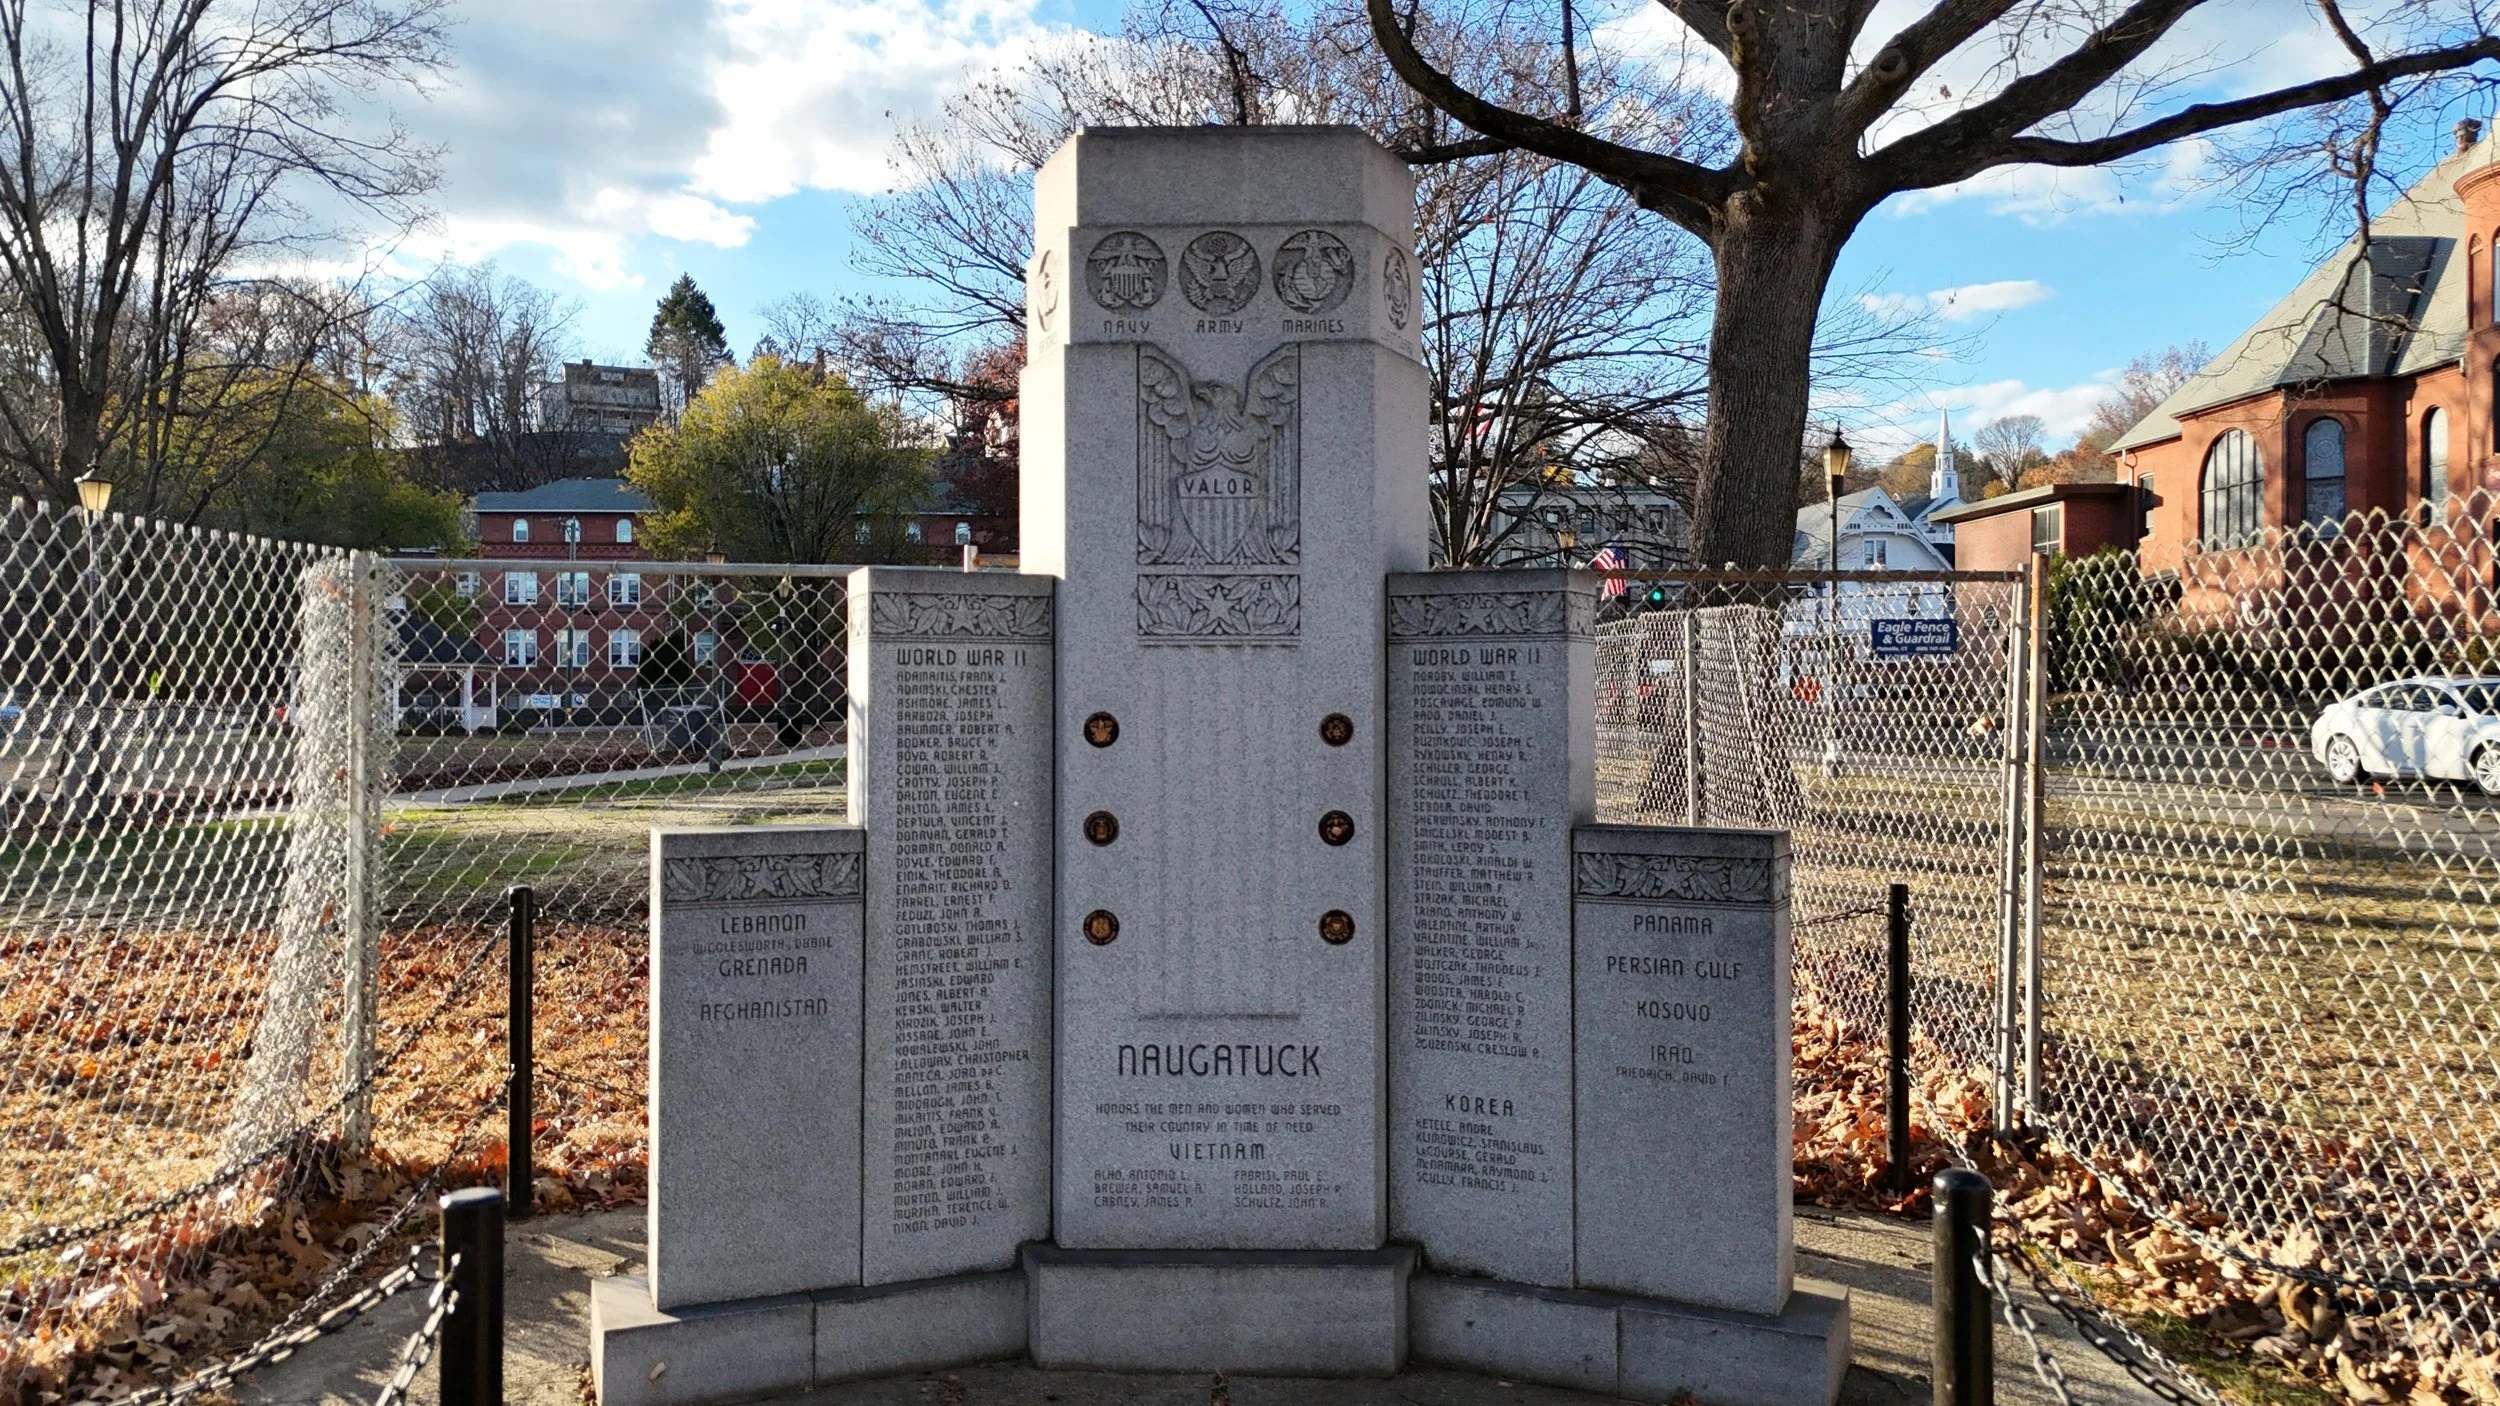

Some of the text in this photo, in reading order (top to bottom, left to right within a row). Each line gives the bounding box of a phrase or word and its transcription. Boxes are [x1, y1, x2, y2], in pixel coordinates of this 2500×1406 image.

[1103, 320, 1149, 334] NAVY
[1196, 320, 1242, 333] ARMY
[1282, 319, 1343, 333] MARINES
[1185, 479, 1252, 494] VALOR
[1878, 622, 1949, 634] Eagle Fence
[1883, 633, 1950, 643] & Guardrail
[898, 649, 1025, 666] WORLD WAR II
[1414, 648, 1539, 665] WORLD WAR II
[960, 672, 994, 682] FRANK
[1462, 671, 1505, 681] WILLIAM
[951, 685, 997, 695] CHESTER
[1485, 685, 1519, 695] HENRY
[958, 698, 991, 708] JAMES
[1482, 698, 1526, 708] EDMUND
[955, 711, 993, 721] JOSEPH
[1448, 711, 1484, 721] DANIEL
[960, 725, 999, 734] ROBERT
[1455, 724, 1493, 734] JOSEPH
[948, 738, 981, 748] BRUCE
[1482, 738, 1521, 747] JOSEPH
[934, 751, 974, 761] ROBERT
[1478, 750, 1512, 760] HENRY
[944, 764, 988, 773] WILLIAM
[1468, 764, 1509, 773] GEORGE
[947, 777, 985, 787] JOSEPH
[1466, 776, 1502, 786] ALBERT
[945, 790, 985, 800] EUGENE
[1465, 790, 1518, 800] THEODORE
[947, 803, 980, 813] JAMES
[1460, 803, 1491, 813] DAVID
[951, 816, 996, 826] VINCENT
[1486, 817, 1534, 828] ANTHONY
[956, 829, 996, 839] GERALD
[1475, 830, 1516, 840] MODEST
[951, 842, 992, 853] DONALD
[1452, 843, 1484, 853] LEROY
[939, 856, 983, 867] EDWARD
[1477, 856, 1517, 867] RINALDI
[934, 868, 986, 880] THEODORE
[1471, 869, 1521, 881] MATTHEW
[952, 881, 998, 892] RICHARD
[1449, 882, 1492, 893] WILLIAM
[944, 895, 983, 906] ERNEST
[1462, 895, 1508, 907] MICHAEL
[941, 909, 967, 919] JOHN
[1458, 908, 1505, 920] ANTHONY
[722, 914, 806, 934] LEBANON
[966, 920, 1007, 931] THOMAS
[1476, 922, 1516, 934] ARTHUR
[1634, 915, 1712, 935] PANAMA
[968, 933, 1010, 944] WILLIAM
[1476, 936, 1520, 948] WILLIAM
[939, 948, 978, 959] ROBERT
[1463, 949, 1504, 960] GEORGE
[719, 956, 807, 977] GRENADA
[966, 959, 1009, 972] WILLIAM
[1476, 963, 1528, 976] THADDEUS
[1607, 956, 1742, 980] PERSIAN GULF
[950, 974, 994, 986] EDWARD
[1459, 976, 1492, 987] JAMES
[937, 988, 974, 1000] ALBERT
[1470, 989, 1511, 1001] HAROLD
[700, 998, 827, 1021] AFGHANISTAN
[941, 1001, 981, 1013] WALTER
[1466, 1002, 1512, 1015] MICHAEL
[1637, 1001, 1710, 1021] KOSOVO
[945, 1014, 983, 1026] JOSEPH
[1467, 1016, 1509, 1028] GEORGE
[949, 1028, 975, 1039] JOHN
[1468, 1029, 1506, 1042] JOSEPH
[972, 1039, 999, 1050] JOHN
[958, 1050, 1029, 1064] CHRISTOPHER
[1118, 1044, 1320, 1076] NAUGATUCK
[1651, 1045, 1694, 1064] IRAQ
[1683, 1072, 1716, 1085] DAVID
[946, 1081, 980, 1093] JAMES
[961, 1094, 988, 1105] JOHN
[1096, 1104, 1340, 1115] HONORS THE MEN AND WOMEN WHO SERVED
[1446, 1095, 1513, 1116] KOREA
[950, 1108, 983, 1119] FRANK
[940, 1120, 985, 1134] EDWARD
[1126, 1122, 1313, 1133] THEIR COUNTRY IN TIME OF NEED
[1459, 1122, 1493, 1135] ANDRE
[943, 1134, 977, 1147] FRANK
[965, 1145, 1005, 1159] EUGENE
[1170, 1143, 1265, 1160] VIETNAM
[1481, 1138, 1544, 1155] STANISLAUS
[1476, 1151, 1516, 1165] GERALD
[941, 1162, 968, 1175] JOHN
[1482, 1165, 1534, 1181] RAYMOND
[941, 1174, 985, 1188] EDWARD
[1130, 1170, 1175, 1181] ANTONIO
[1284, 1171, 1310, 1182] PAUL
[1147, 1184, 1188, 1194] SAMUEL
[1290, 1184, 1330, 1195] JOSEPH
[1462, 1177, 1505, 1192] FRANCIS
[947, 1187, 991, 1201] WILLIAM
[947, 1200, 992, 1214] TERENCE
[1144, 1197, 1179, 1208] JAMES
[1288, 1198, 1315, 1208] JOHN
[935, 1216, 966, 1229] DAVID
